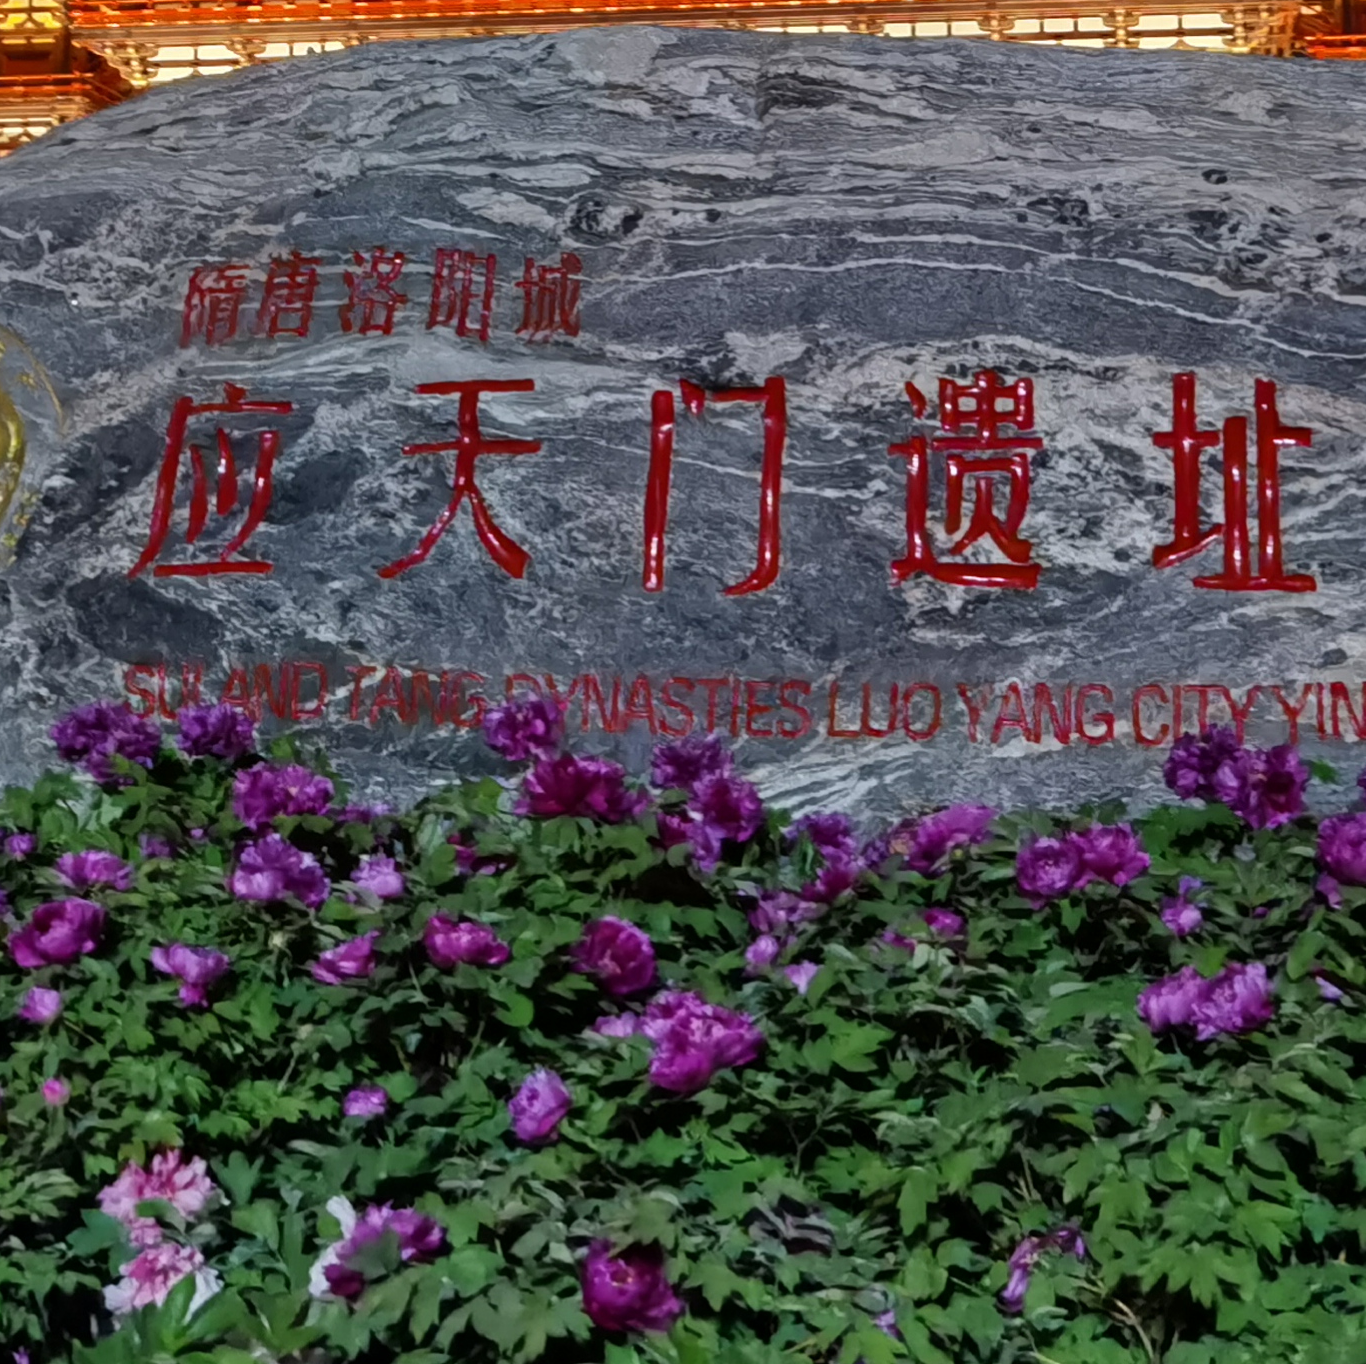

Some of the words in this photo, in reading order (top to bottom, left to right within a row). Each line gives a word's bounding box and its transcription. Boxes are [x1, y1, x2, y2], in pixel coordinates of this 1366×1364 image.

[178, 245, 583, 349] 隋唐洛阳城
[221, 660, 328, 722] AND
[344, 665, 485, 728] TANG
[826, 680, 942, 741] LUO
[956, 679, 1115, 746] YANG
[1132, 681, 1263, 746] CITY
